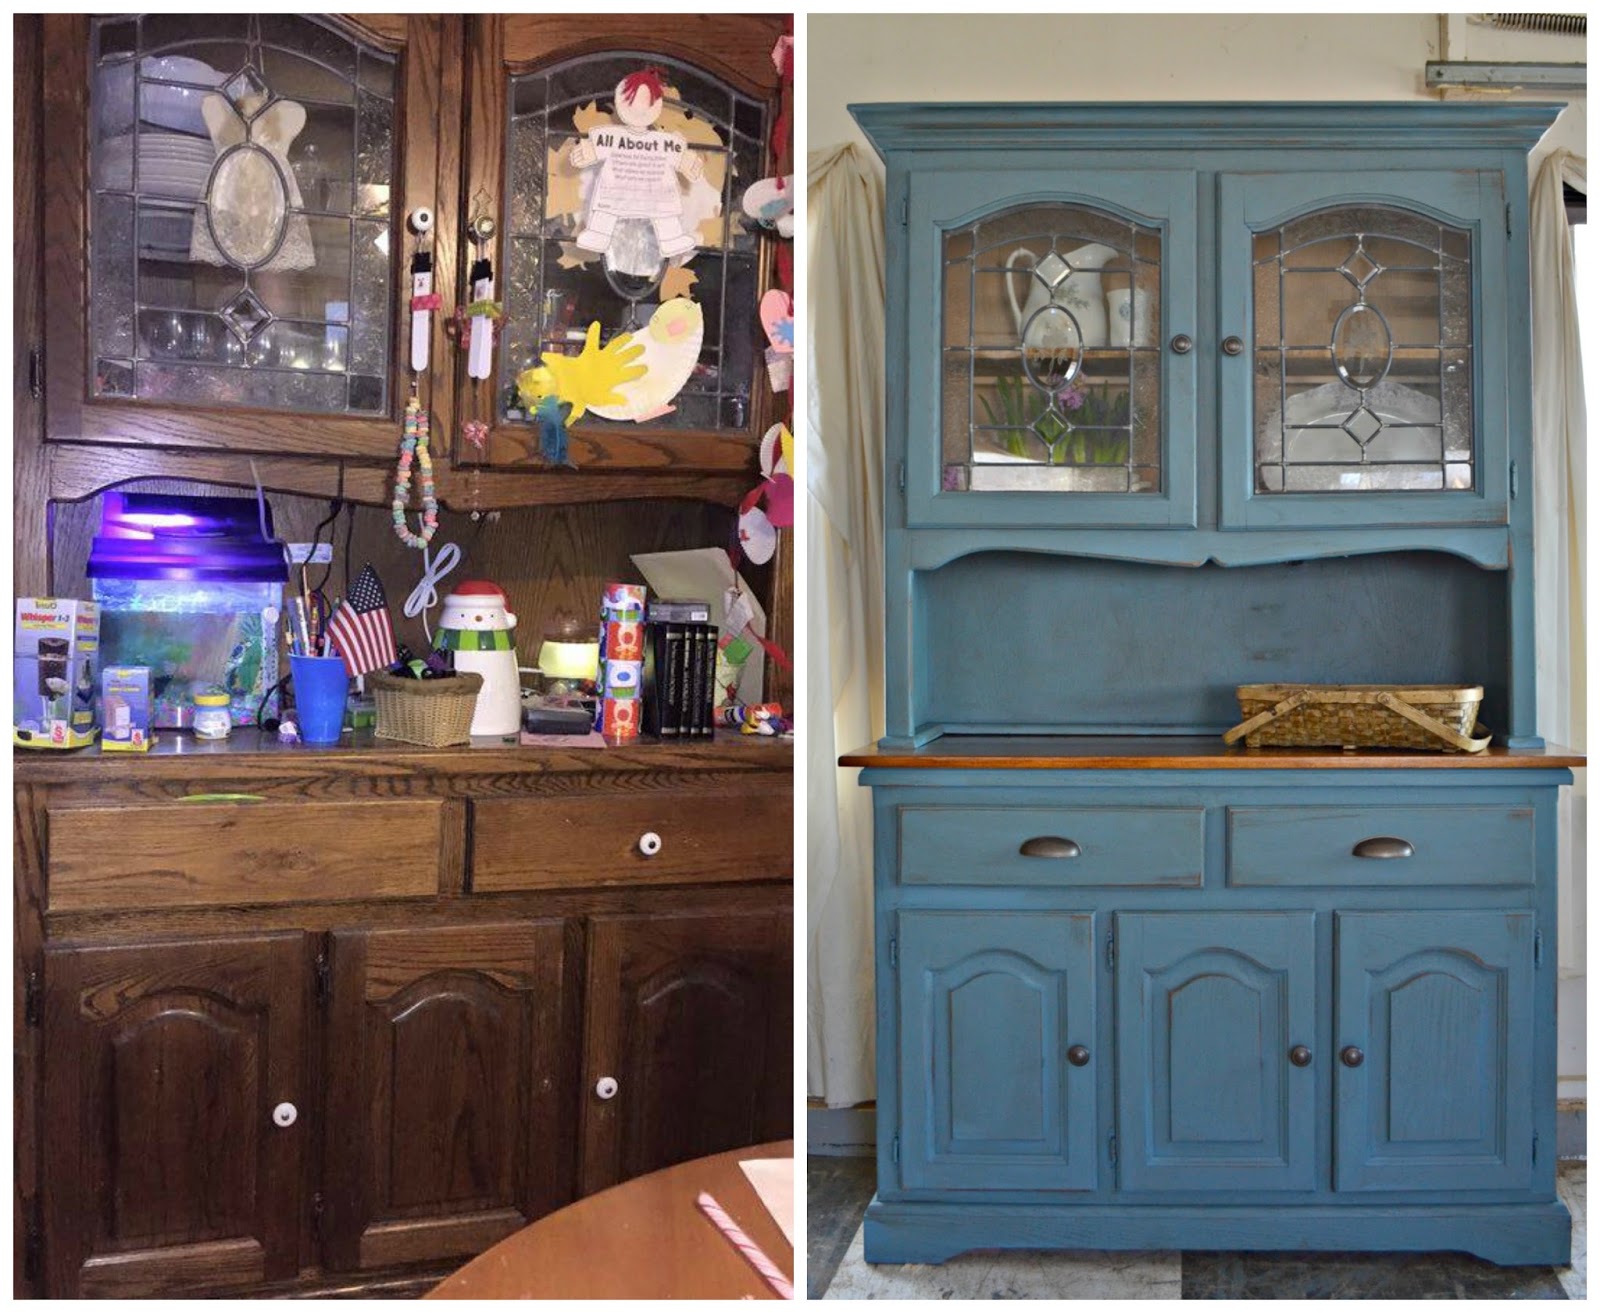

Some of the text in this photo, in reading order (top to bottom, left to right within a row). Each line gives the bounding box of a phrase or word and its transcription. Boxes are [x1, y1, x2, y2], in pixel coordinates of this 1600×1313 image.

[596, 134, 682, 153] All About Me
[21, 612, 56, 623] Whisper
